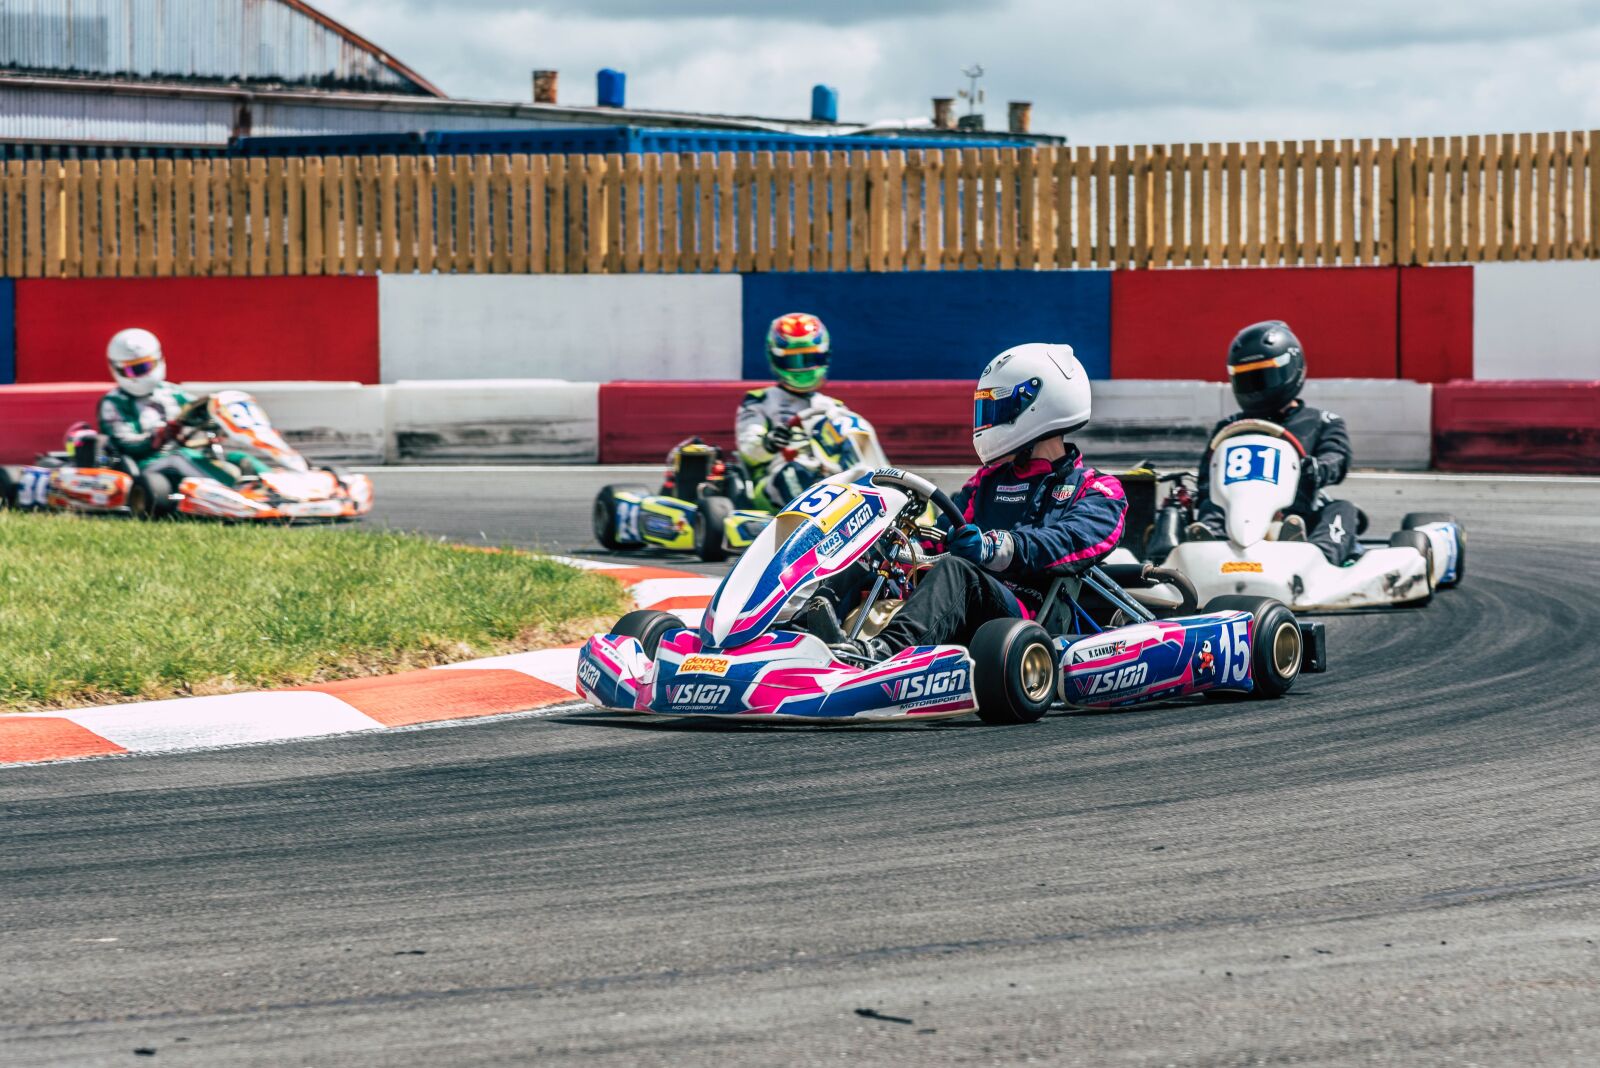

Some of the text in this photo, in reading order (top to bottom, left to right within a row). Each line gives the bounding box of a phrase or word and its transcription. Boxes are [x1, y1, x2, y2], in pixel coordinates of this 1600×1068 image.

[1226, 446, 1276, 479] 81
[822, 532, 841, 552] HRS
[686, 656, 729, 667] demon
[1218, 621, 1250, 684] 15
[680, 664, 727, 674] tweeks
[1073, 662, 1149, 696] VISION
[666, 684, 732, 705] VISION
[880, 669, 967, 702] VISION
[900, 695, 962, 710] MOTORSPORT
